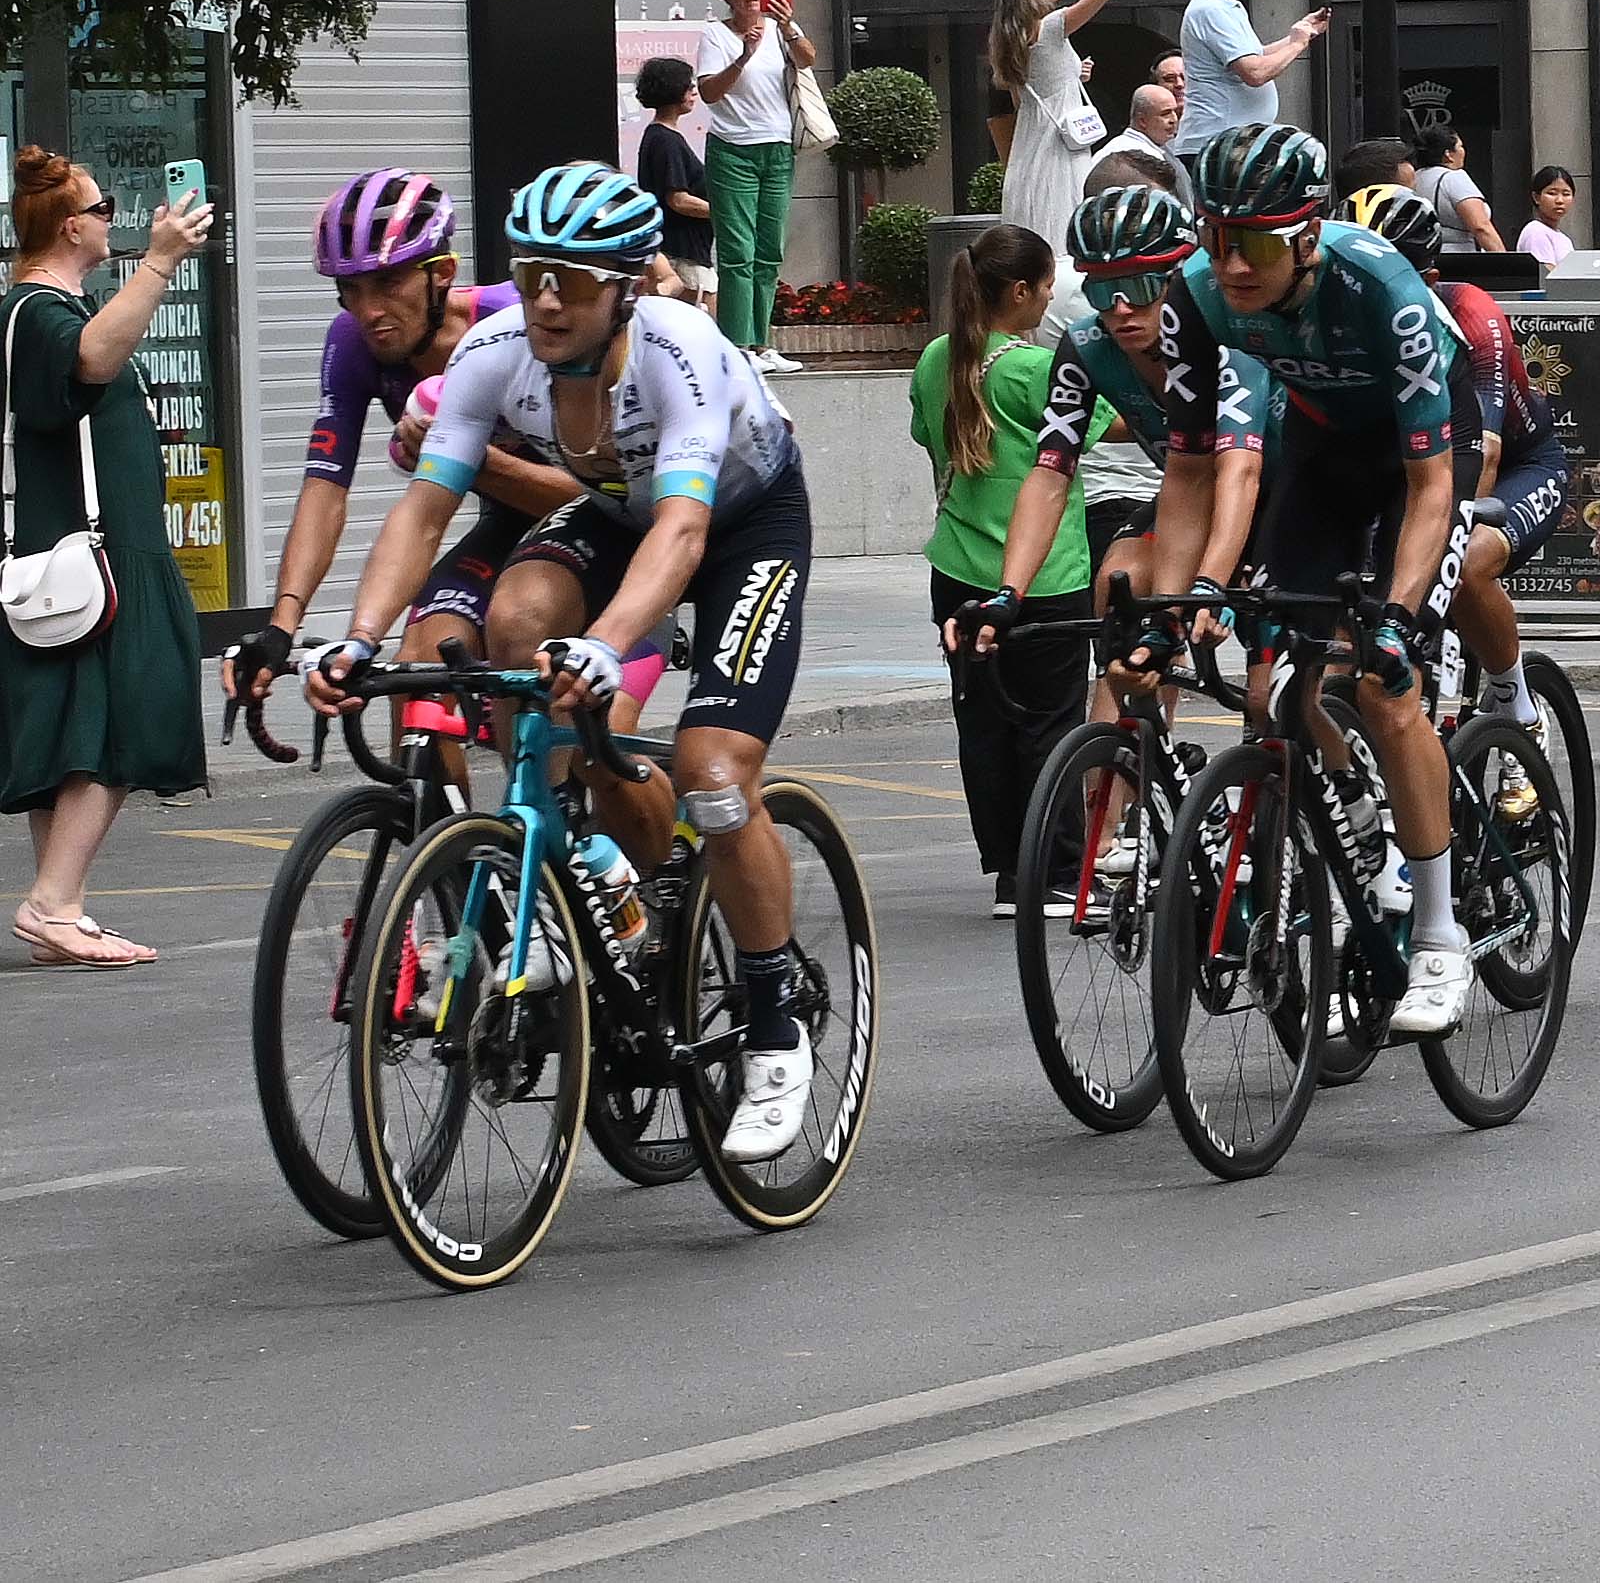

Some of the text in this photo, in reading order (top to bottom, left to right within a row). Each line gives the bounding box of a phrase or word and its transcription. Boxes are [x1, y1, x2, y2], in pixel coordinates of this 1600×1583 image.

[1511, 315, 1596, 335] Restaurante
[187, 500, 222, 547] 453
[1511, 478, 1562, 536] INEOS
[1427, 500, 1476, 621] BORA
[713, 559, 783, 679] ASTANA
